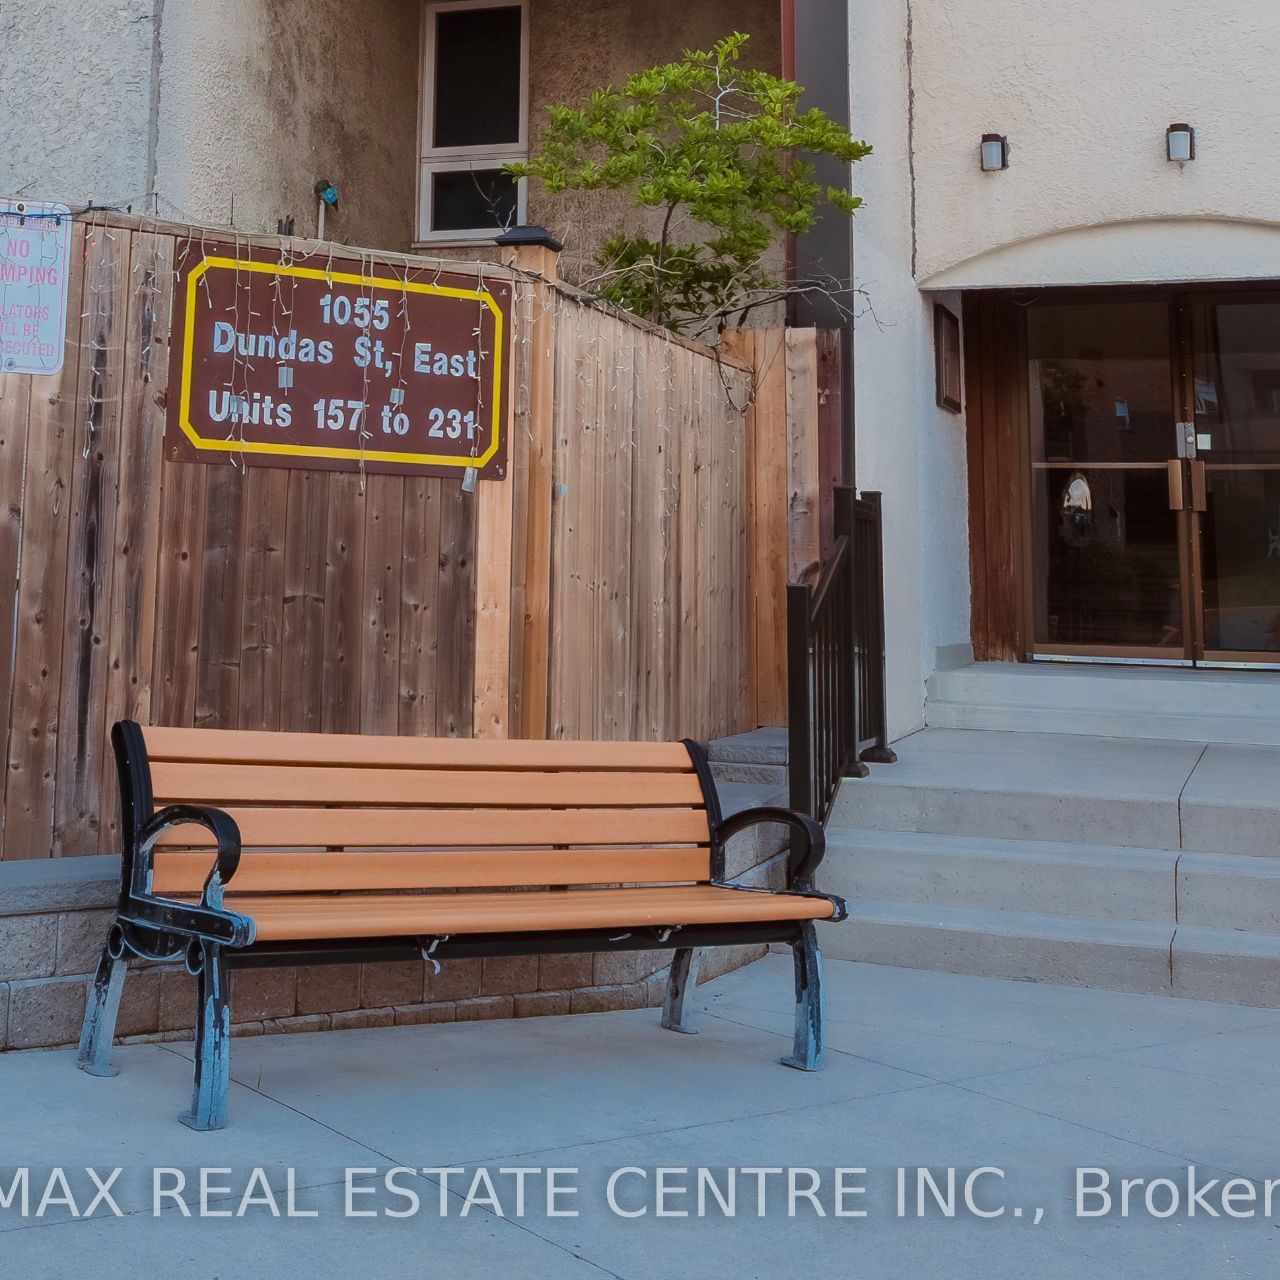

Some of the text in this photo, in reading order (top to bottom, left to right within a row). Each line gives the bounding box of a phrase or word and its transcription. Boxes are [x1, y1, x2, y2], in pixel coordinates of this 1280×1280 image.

[6, 239, 30, 257] NO
[23, 322, 39, 337] BE
[320, 293, 390, 330] 1055
[213, 321, 333, 364] Dundas
[413, 342, 477, 378] East
[208, 389, 475, 439] Units 157 to 231
